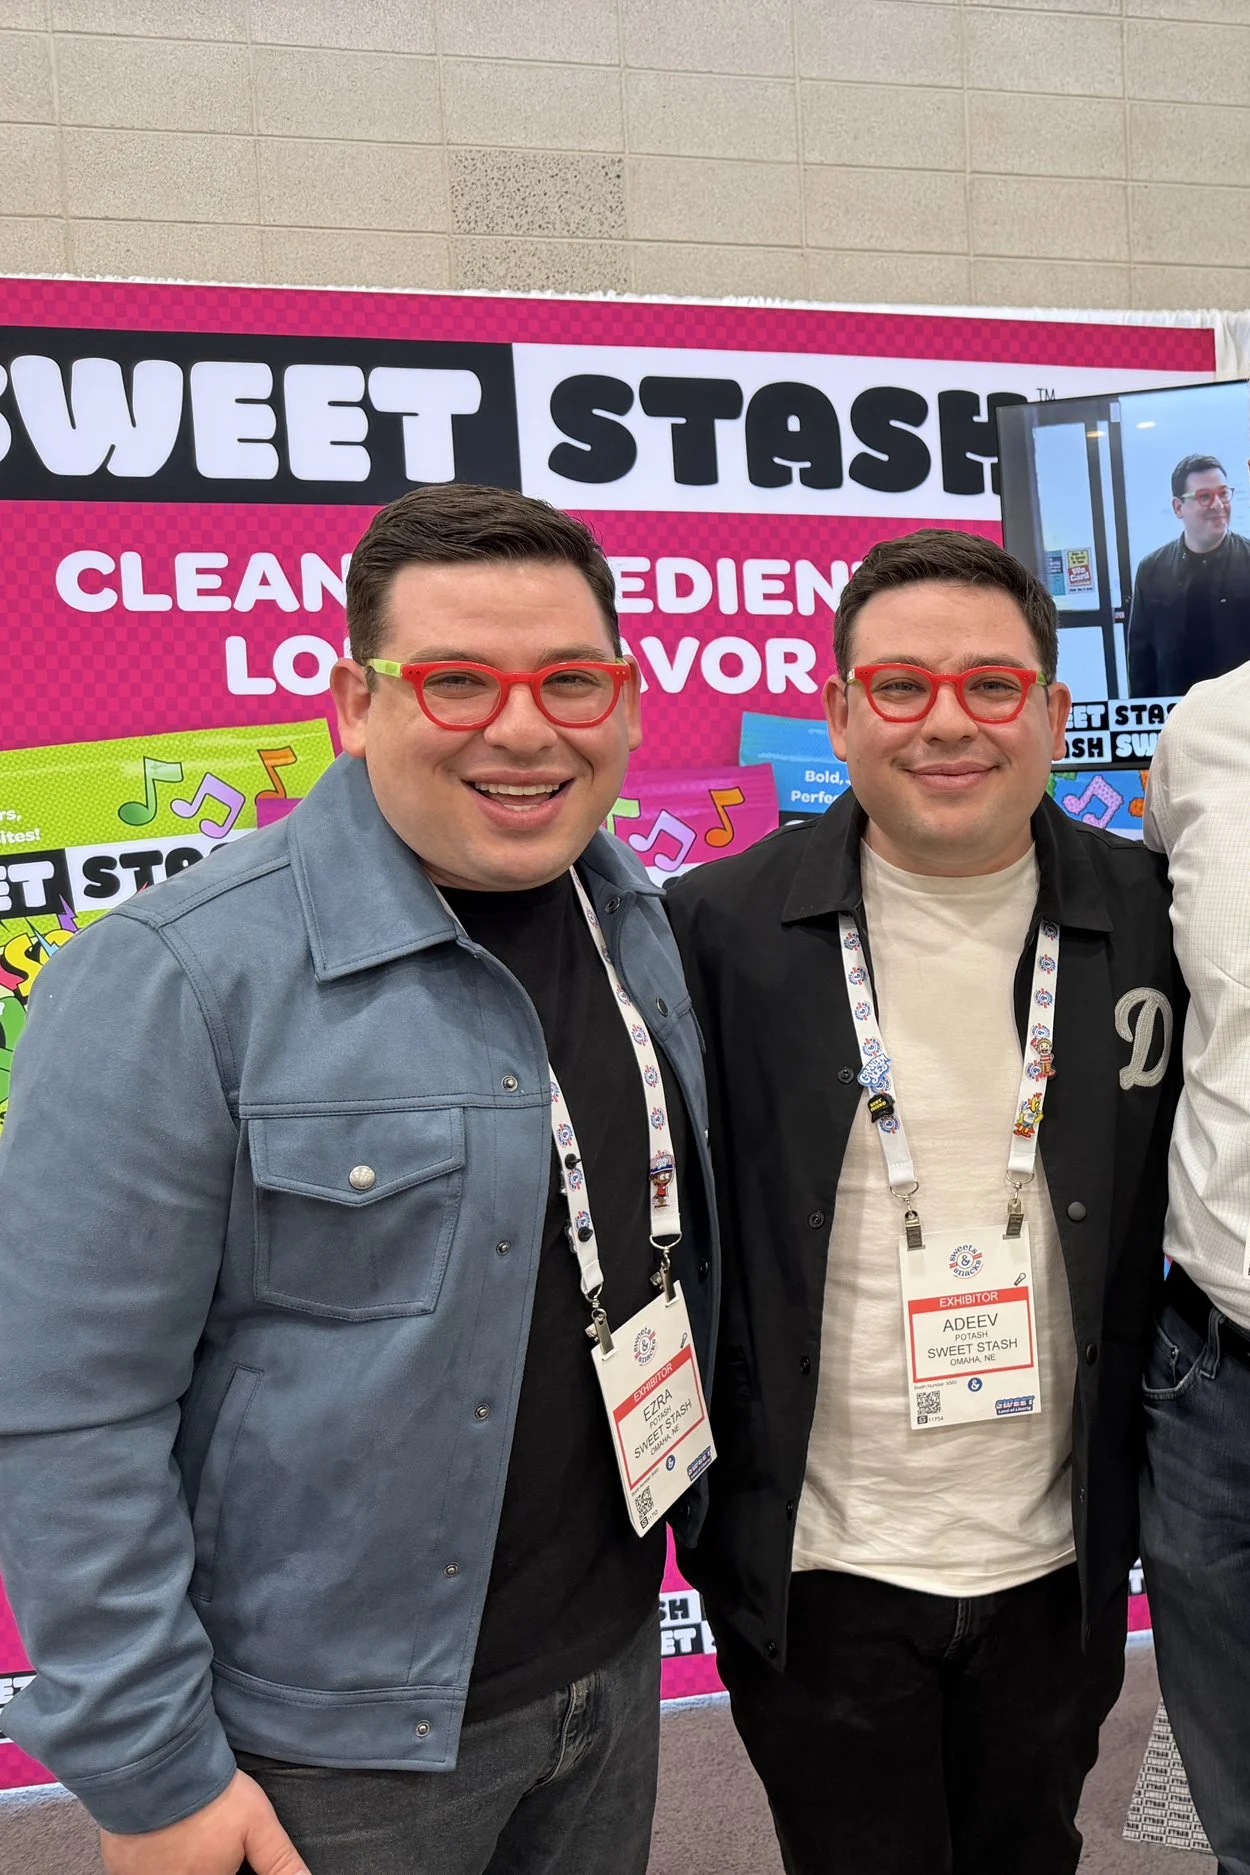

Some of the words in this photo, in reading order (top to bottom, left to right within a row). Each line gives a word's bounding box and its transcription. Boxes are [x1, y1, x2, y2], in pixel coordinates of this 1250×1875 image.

[0, 355, 482, 483] WEET
[607, 556, 863, 616] EDIEN
[225, 635, 352, 696] LO
[1065, 737, 1104, 758] SH
[805, 770, 844, 786] Bold,
[0, 827, 41, 845] ites!
[939, 1291, 999, 1308] EXHIBITOR
[943, 1313, 999, 1333] ADEEV
[955, 1331, 988, 1341] POTASH
[928, 1343, 974, 1360] SWEET
[977, 1338, 1018, 1352] STASH
[950, 1356, 983, 1366] OMAHA,
[984, 1354, 996, 1362] NE
[634, 1363, 673, 1403] EXHIBITOR
[643, 1389, 673, 1422] EZRA
[649, 1405, 672, 1430] POTASH
[634, 1424, 664, 1459] SWEET
[665, 1399, 692, 1431] STASH
[671, 1424, 680, 1436] NE
